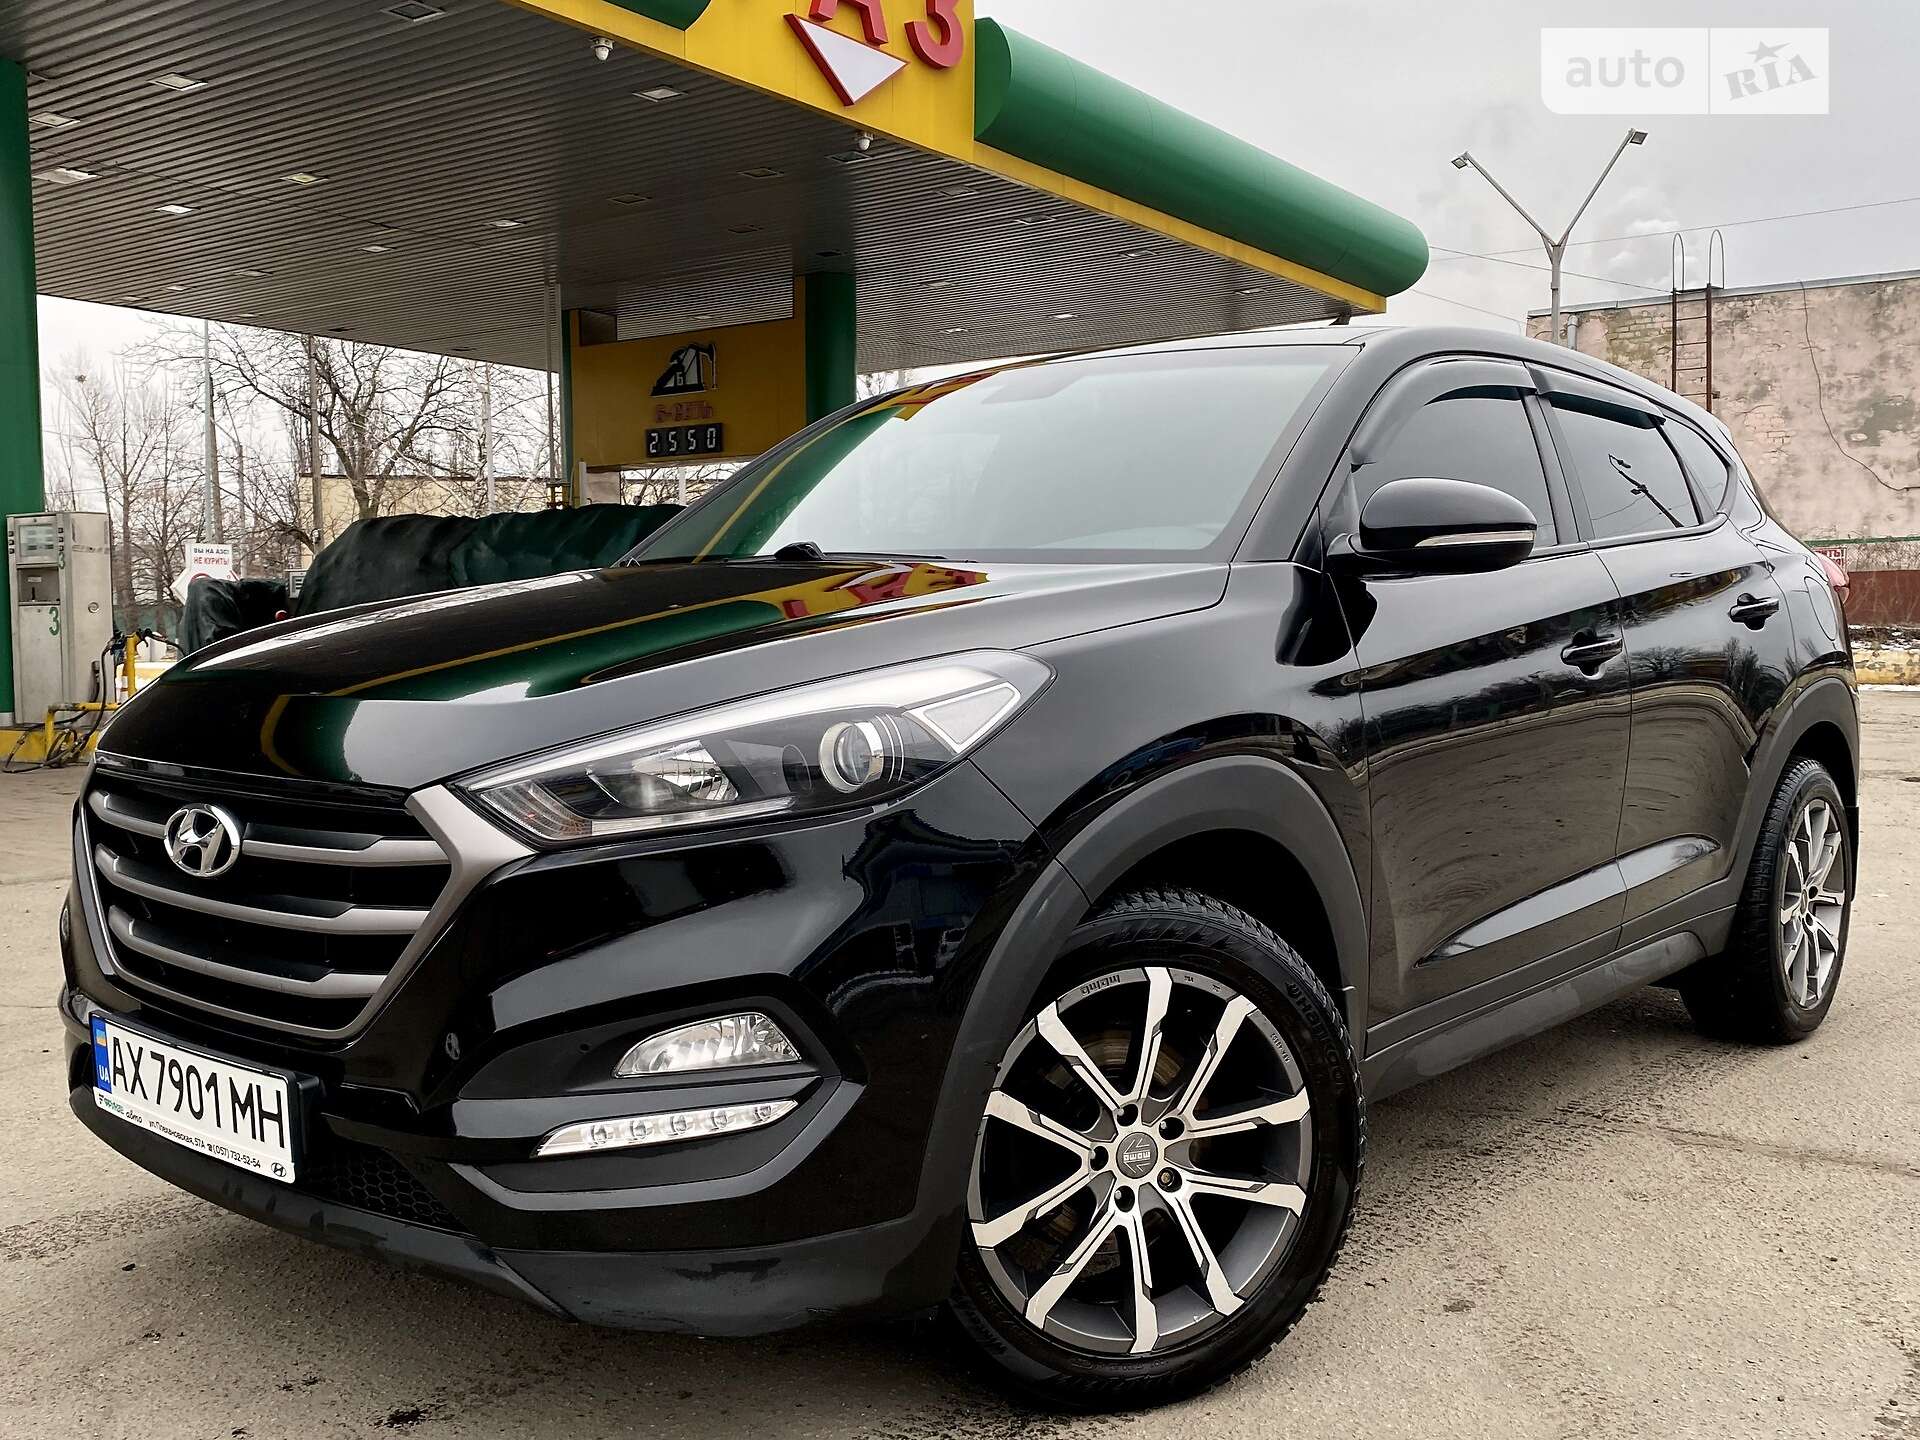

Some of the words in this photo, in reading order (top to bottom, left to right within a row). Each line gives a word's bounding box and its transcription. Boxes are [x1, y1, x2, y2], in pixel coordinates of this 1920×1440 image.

[194, 557, 202, 565] НЕ
[48, 607, 60, 636] 3
[98, 1064, 111, 1084] UA
[113, 1036, 148, 1101] AX
[150, 1050, 222, 1129] 7901
[229, 1076, 285, 1149] MH
